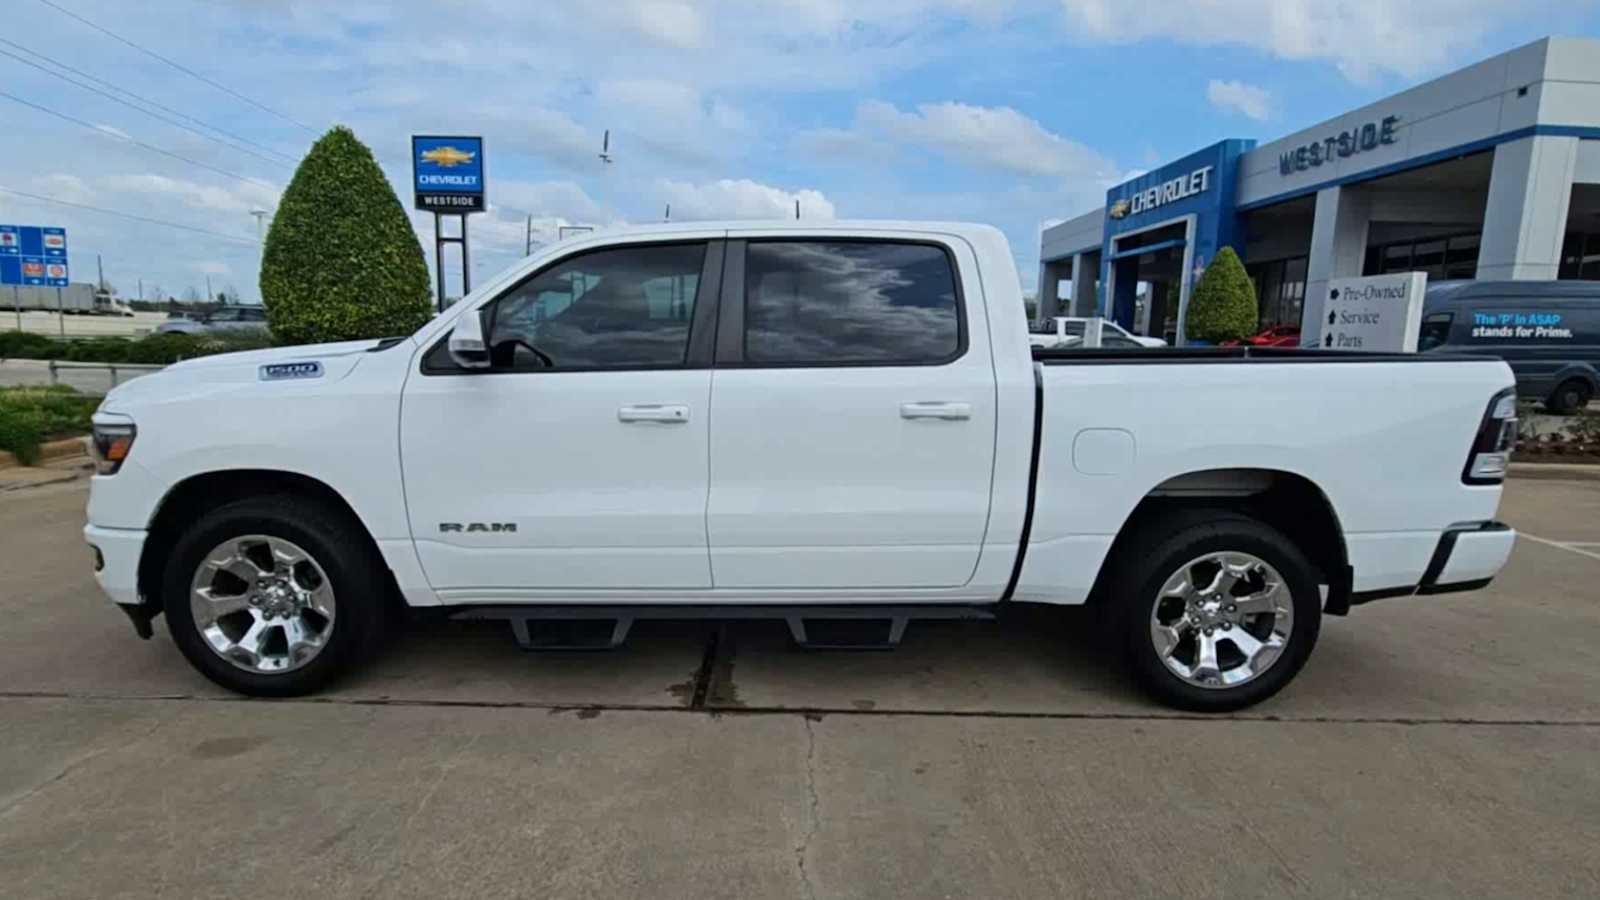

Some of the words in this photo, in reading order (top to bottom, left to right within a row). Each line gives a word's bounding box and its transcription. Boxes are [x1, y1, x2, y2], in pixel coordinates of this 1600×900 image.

[1279, 115, 1398, 175] WESTSIDE
[420, 175, 477, 185] CHEVROLET
[1131, 165, 1214, 214] CHEVROLET
[424, 196, 475, 206] WESTSIDE
[1343, 282, 1406, 300] Pre-Owned
[1340, 309, 1380, 324] Service
[1474, 313, 1496, 325] The
[1528, 313, 1561, 325] ASAP
[1472, 327, 1512, 338] stands
[1515, 326, 1534, 338] for
[1535, 327, 1573, 338] Prime.
[1337, 333, 1362, 347] Parts
[439, 523, 517, 533] RAM
